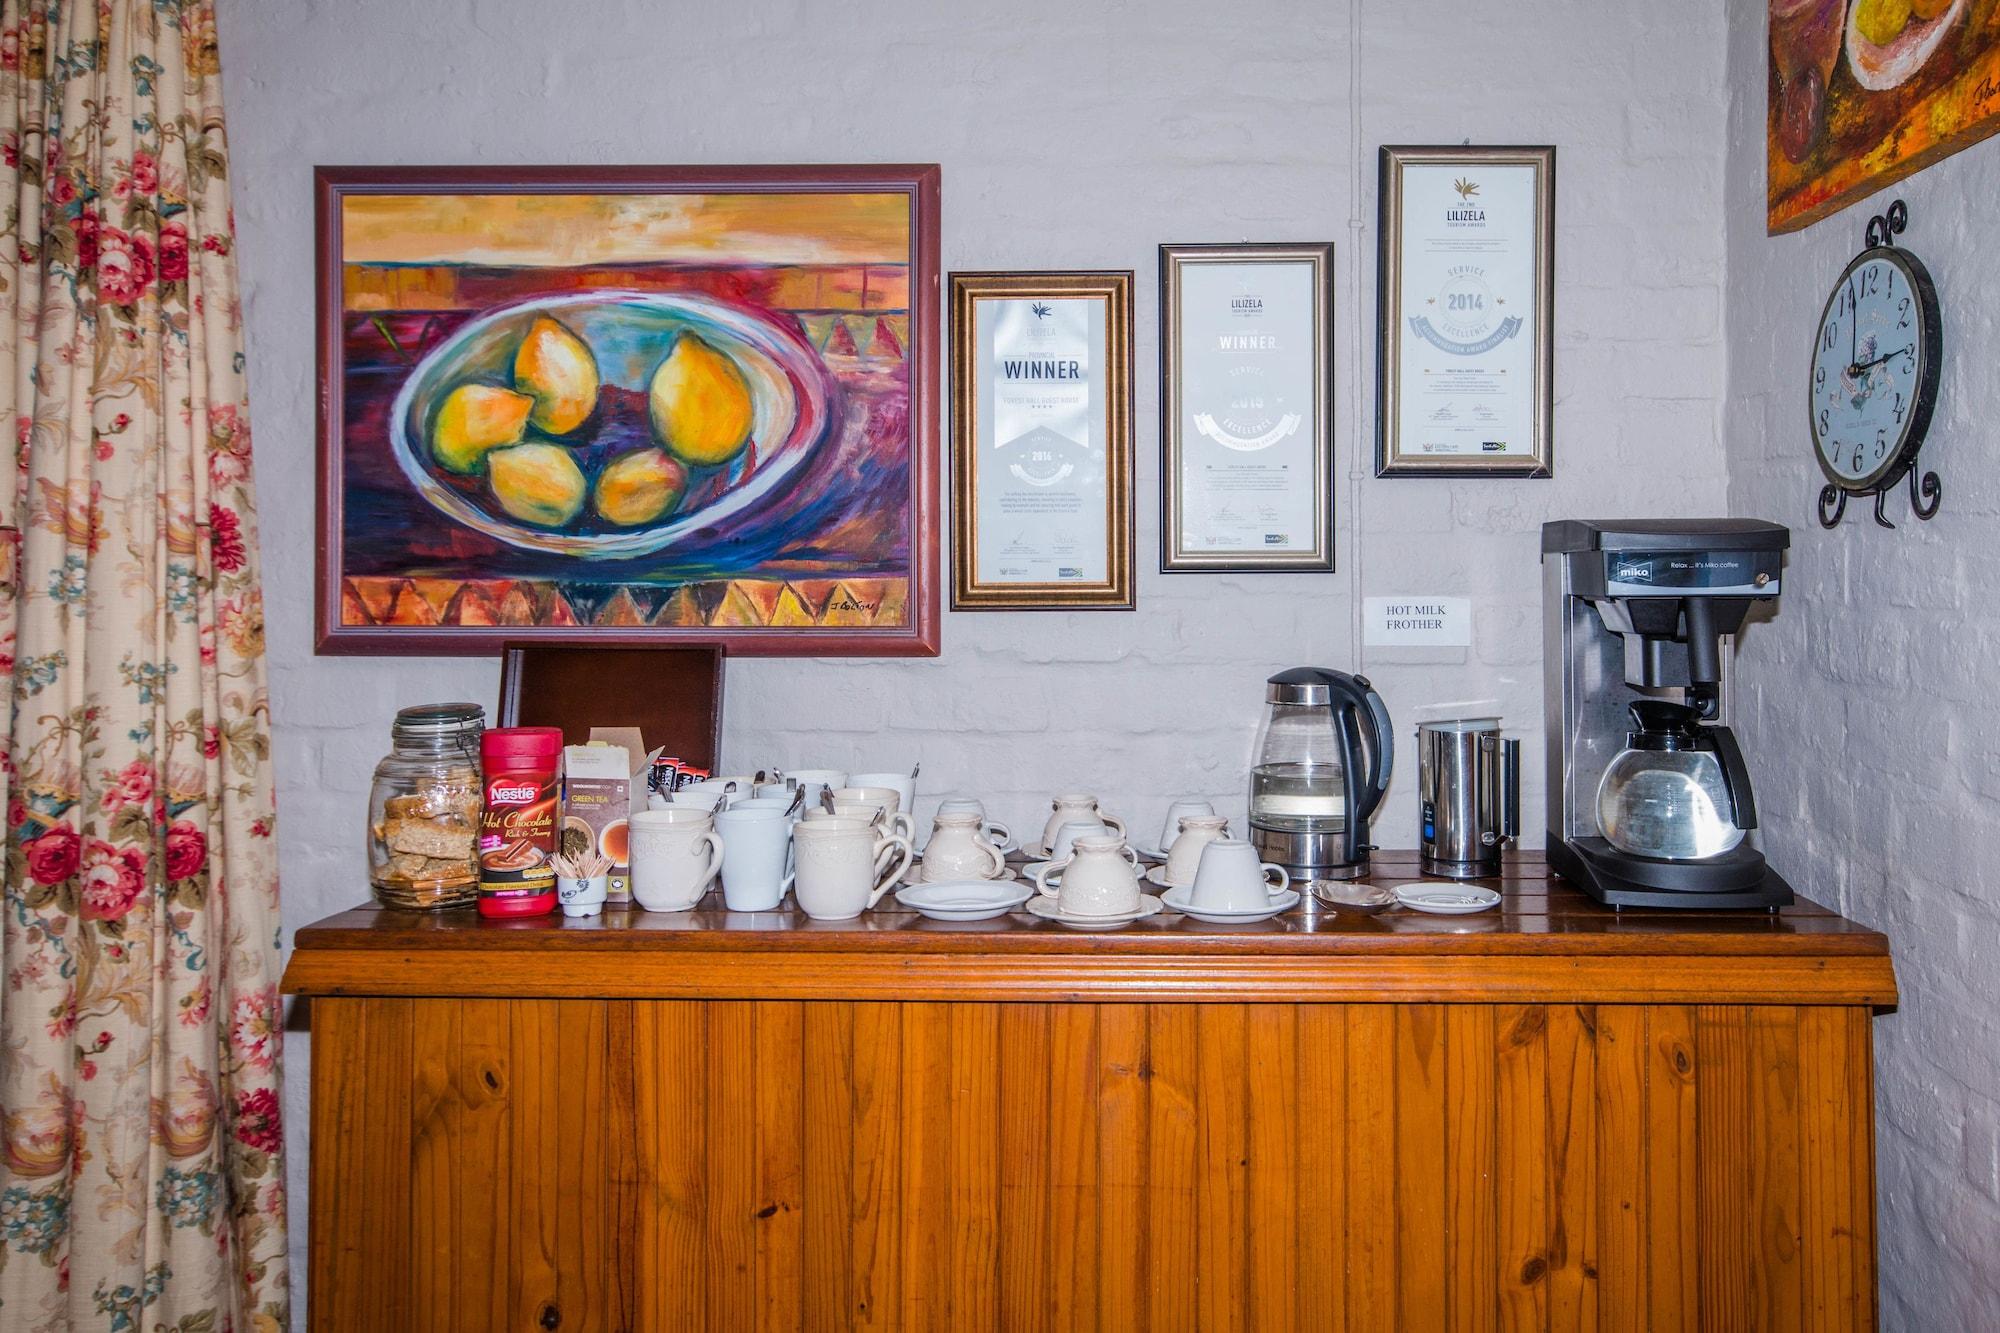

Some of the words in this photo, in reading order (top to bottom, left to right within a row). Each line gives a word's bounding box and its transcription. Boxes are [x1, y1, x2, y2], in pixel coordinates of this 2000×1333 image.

[1447, 210, 1485, 221] LILIZELA
[1447, 265, 1485, 277] SERVICE
[1860, 265, 1879, 300] 12
[1888, 269, 1893, 300] 1
[1231, 299, 1263, 308] LILIZELA
[1448, 293, 1483, 310] 2014
[1897, 298, 1910, 331] 2
[1219, 336, 1277, 349] WINNER
[1823, 321, 1838, 352] 10
[1004, 360, 1080, 379] WINNER
[1816, 366, 1826, 394] 9
[1892, 392, 1905, 424] 4
[1820, 409, 1829, 437] 8
[1831, 440, 1841, 463] 7
[1874, 427, 1888, 459] 5
[1852, 443, 1864, 472] 6
[1620, 566, 1649, 577] miko
[1386, 605, 1412, 615] HOT
[1415, 605, 1446, 615] MILK
[1387, 619, 1442, 630] FROTHER
[571, 794, 594, 802] GREEN
[595, 795, 609, 803] TEA
[482, 811, 501, 828] Hot
[503, 809, 552, 829] Chocolate
